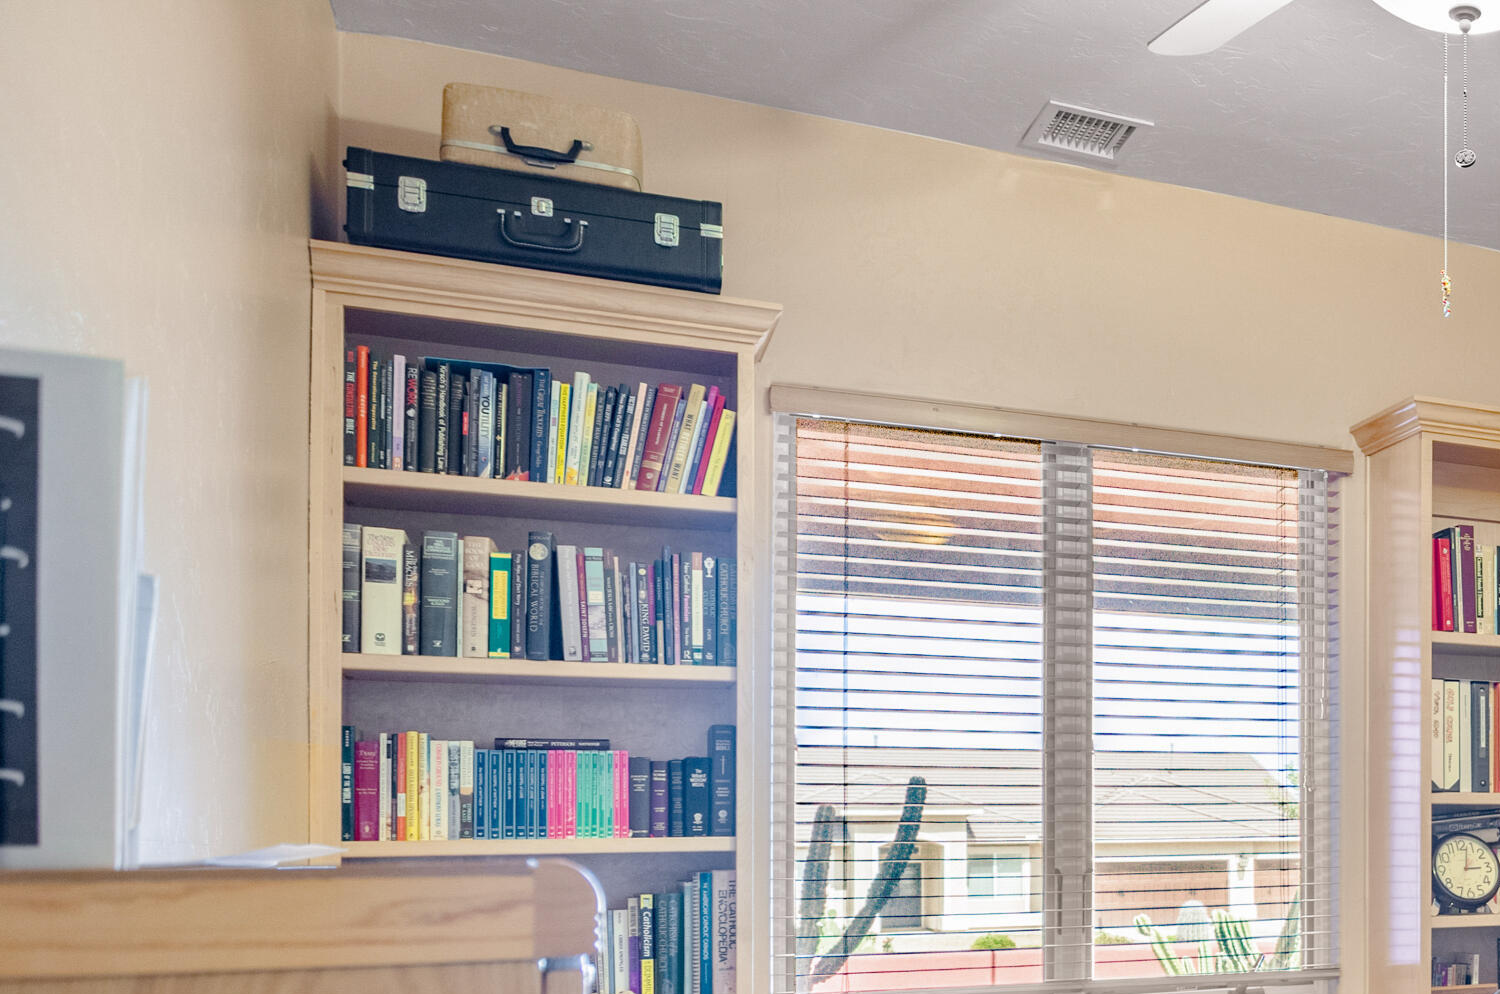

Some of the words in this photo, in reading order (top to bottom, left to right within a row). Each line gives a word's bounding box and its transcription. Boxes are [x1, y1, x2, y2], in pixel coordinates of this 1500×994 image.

[408, 368, 417, 405] REWORK
[481, 396, 490, 439] YOUTILITY
[684, 414, 694, 430] WHAT
[346, 419, 354, 434] BIBLE
[437, 427, 445, 455] Publishing
[672, 463, 681, 480] WANT
[531, 564, 539, 596] BIBLICAL
[720, 563, 728, 600] CATHOLIC
[529, 601, 538, 632] WORLD
[720, 601, 728, 634] CHURCH
[641, 626, 650, 652] DAVID
[343, 763, 351, 774] LORD
[343, 788, 351, 803] WORLD
[1446, 843, 1455, 856] 11
[1455, 840, 1467, 851] 12
[1469, 842, 1474, 853] 1
[1438, 852, 1449, 863] 10
[1477, 848, 1486, 859] 2
[1438, 865, 1446, 876] 9
[1484, 862, 1492, 873] 3
[1445, 878, 1453, 889] 8
[1483, 875, 1491, 885] 4
[1457, 887, 1464, 896] 7
[1467, 888, 1475, 897] 6
[1476, 885, 1485, 896] 5
[658, 900, 667, 938] CATHOLIC
[718, 890, 727, 963] ENCYCLOPEDIA
[643, 911, 651, 957] Catholicism
[659, 940, 667, 972] CHURCH
